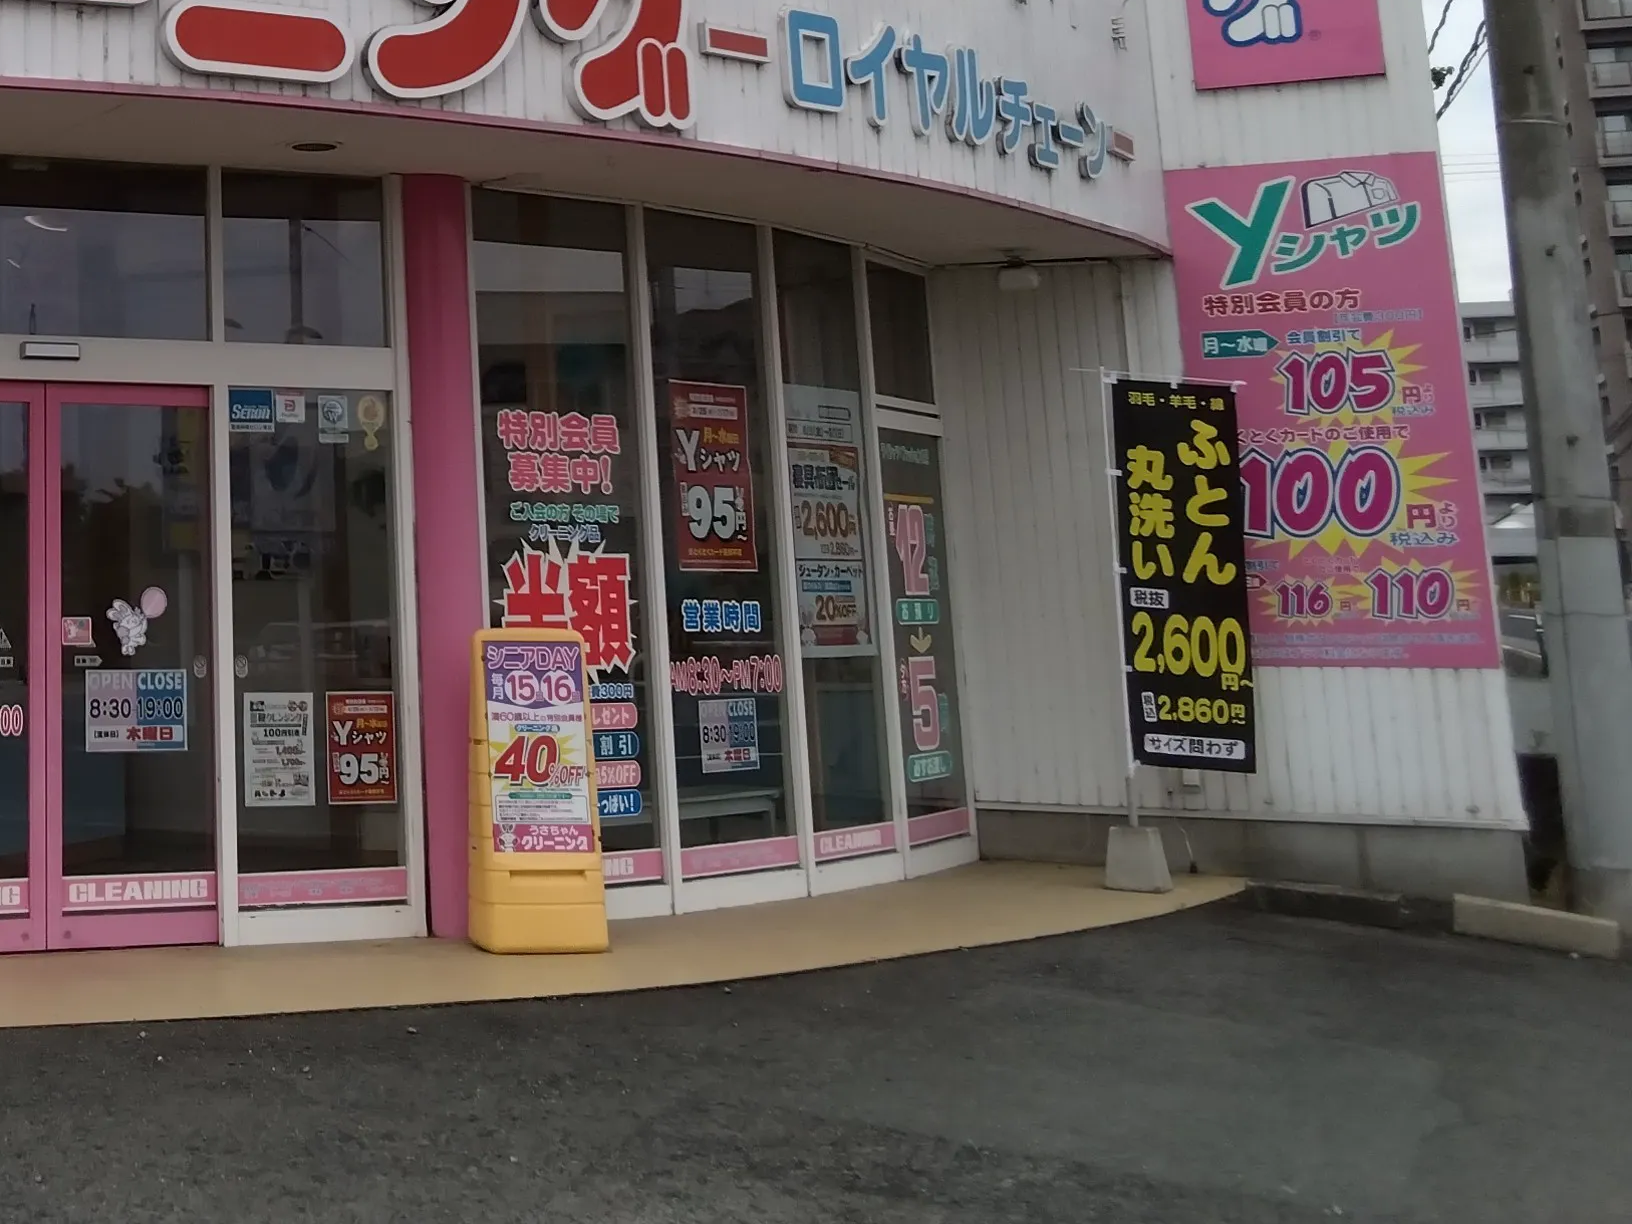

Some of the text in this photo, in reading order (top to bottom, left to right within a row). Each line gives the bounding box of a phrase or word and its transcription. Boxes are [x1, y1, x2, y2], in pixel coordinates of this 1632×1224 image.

[778, 4, 1107, 179] ロイヤルチェーン
[1186, 176, 1421, 291] Yシャツ
[1203, 288, 1361, 317] 特別会員の方
[497, 409, 620, 454] 特別会員
[1237, 426, 1409, 444] くとくカードのご使用で
[675, 428, 741, 473] Yシャツ
[1126, 444, 1174, 581] 丸洗い
[1177, 419, 1236, 586] ふとん
[1390, 531, 1457, 546] 税込み
[1134, 589, 1165, 607] 税抜
[680, 598, 762, 634] 営業時間
[487, 645, 580, 672] シニアDAY
[88, 672, 183, 691] OPEN CLOSE
[491, 673, 504, 700] 毎月
[90, 696, 184, 720] 8:30 19:00
[592, 706, 630, 725] レゼント
[728, 701, 754, 717] CLOSE
[332, 720, 388, 746] Yシャツ
[702, 724, 727, 744] 8:30
[1148, 736, 1238, 757] サイズ問わず
[528, 825, 579, 836] うさちゃん
[69, 878, 209, 904] CLEANING
